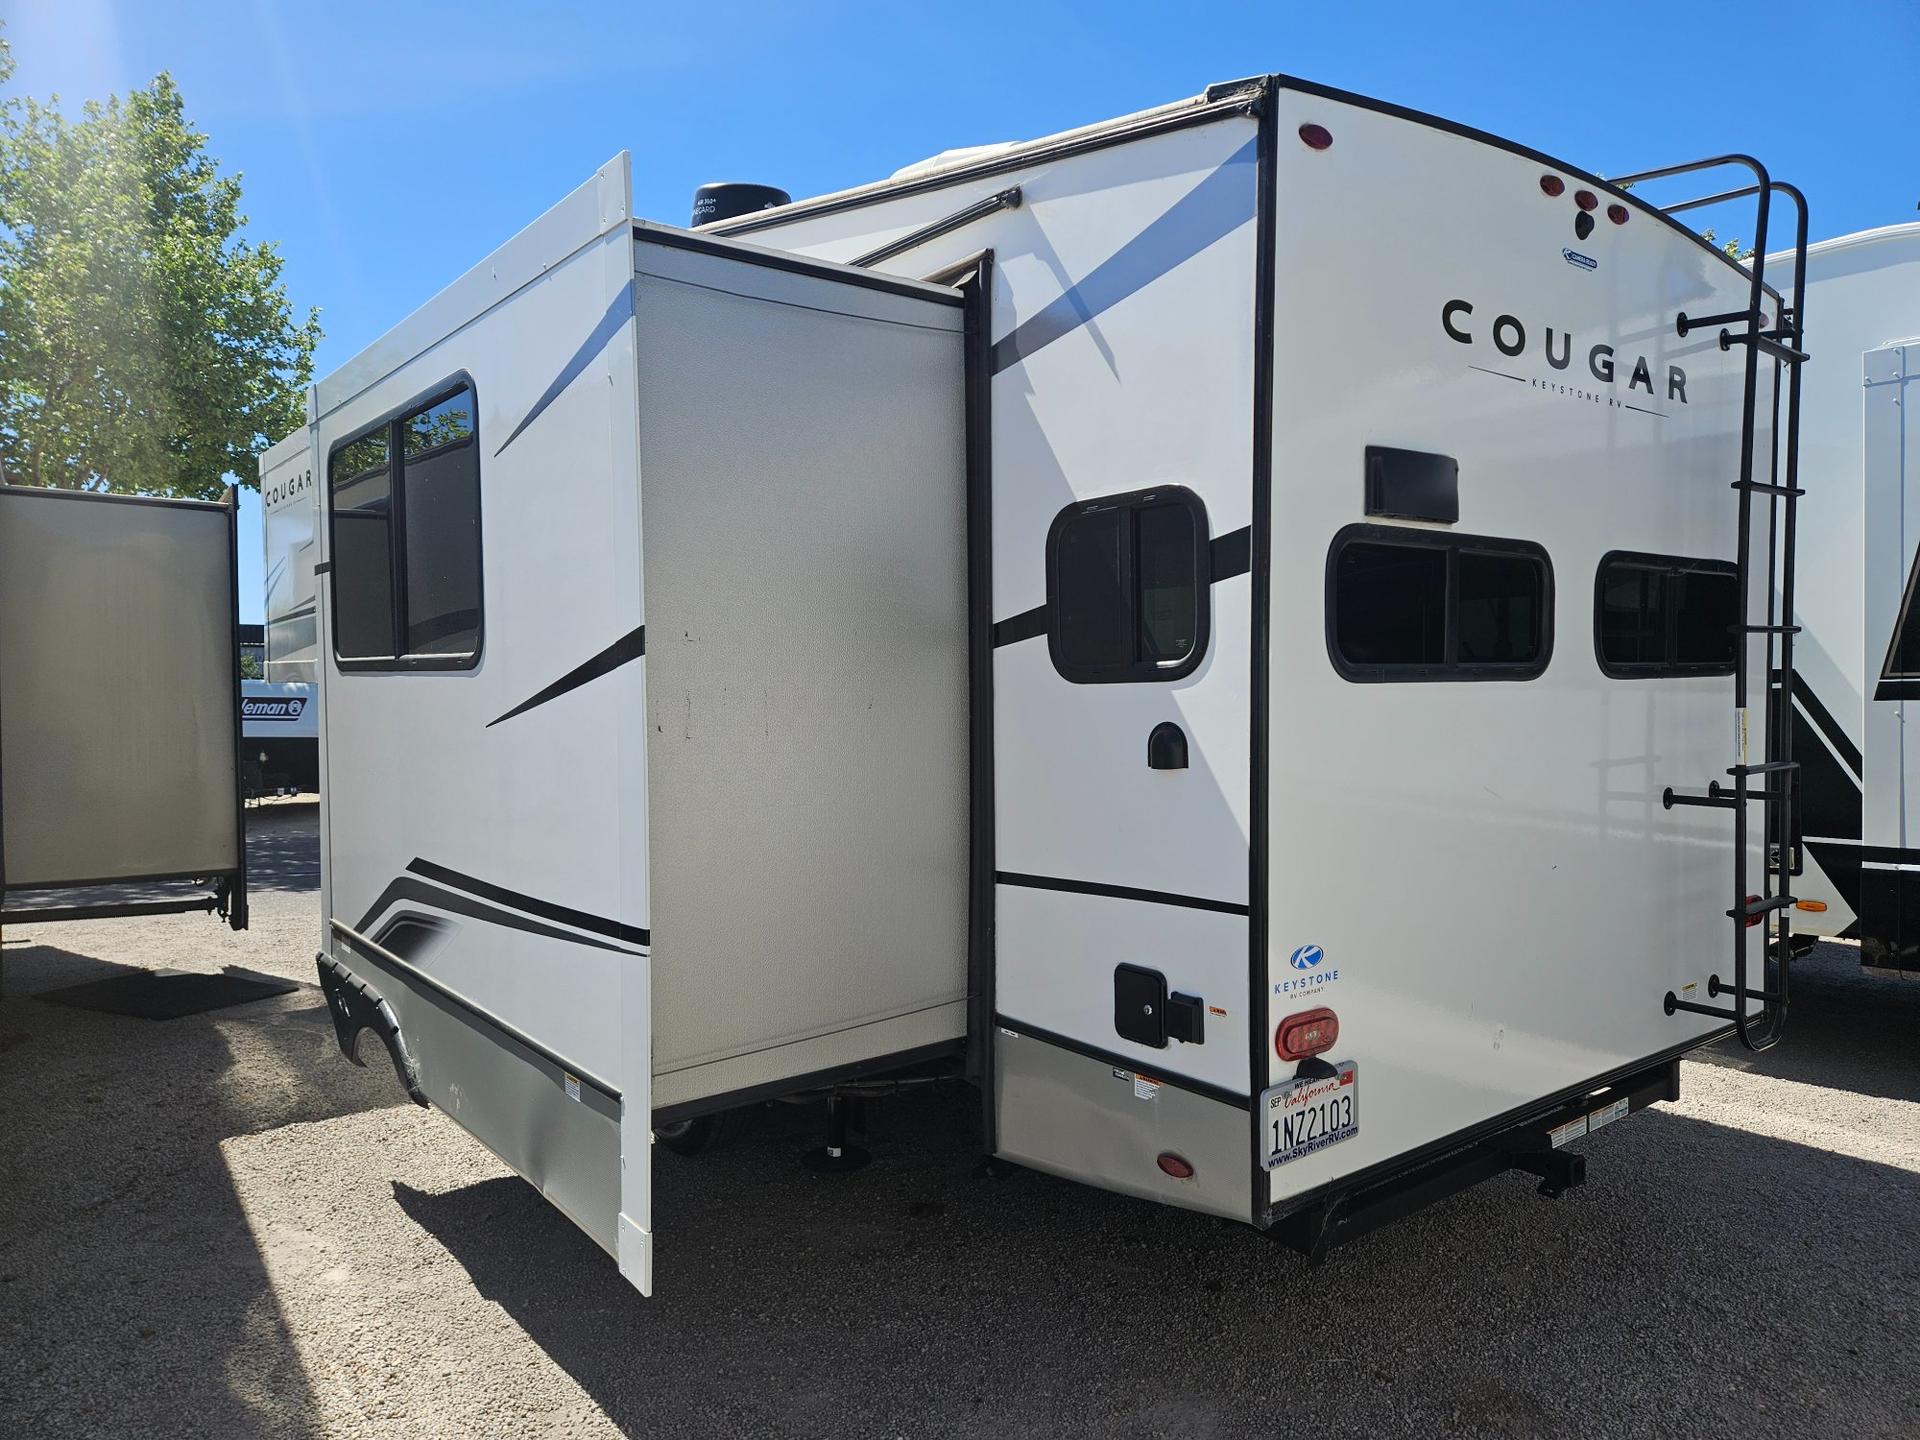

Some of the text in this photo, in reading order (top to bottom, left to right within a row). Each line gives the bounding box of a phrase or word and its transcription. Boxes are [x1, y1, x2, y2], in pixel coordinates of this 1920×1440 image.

[1442, 299, 1688, 404] COUGAR
[1532, 377, 1622, 409] KEYSTONE RV
[265, 469, 312, 507] COUGAR
[1274, 970, 1339, 995] KEYSTONE
[1299, 986, 1325, 998] COMPANY
[1270, 1081, 1341, 1109] SEP California
[1271, 1095, 1352, 1156] 1NZ2103
[1268, 1125, 1358, 1169] www.SkyRiverRV.com
